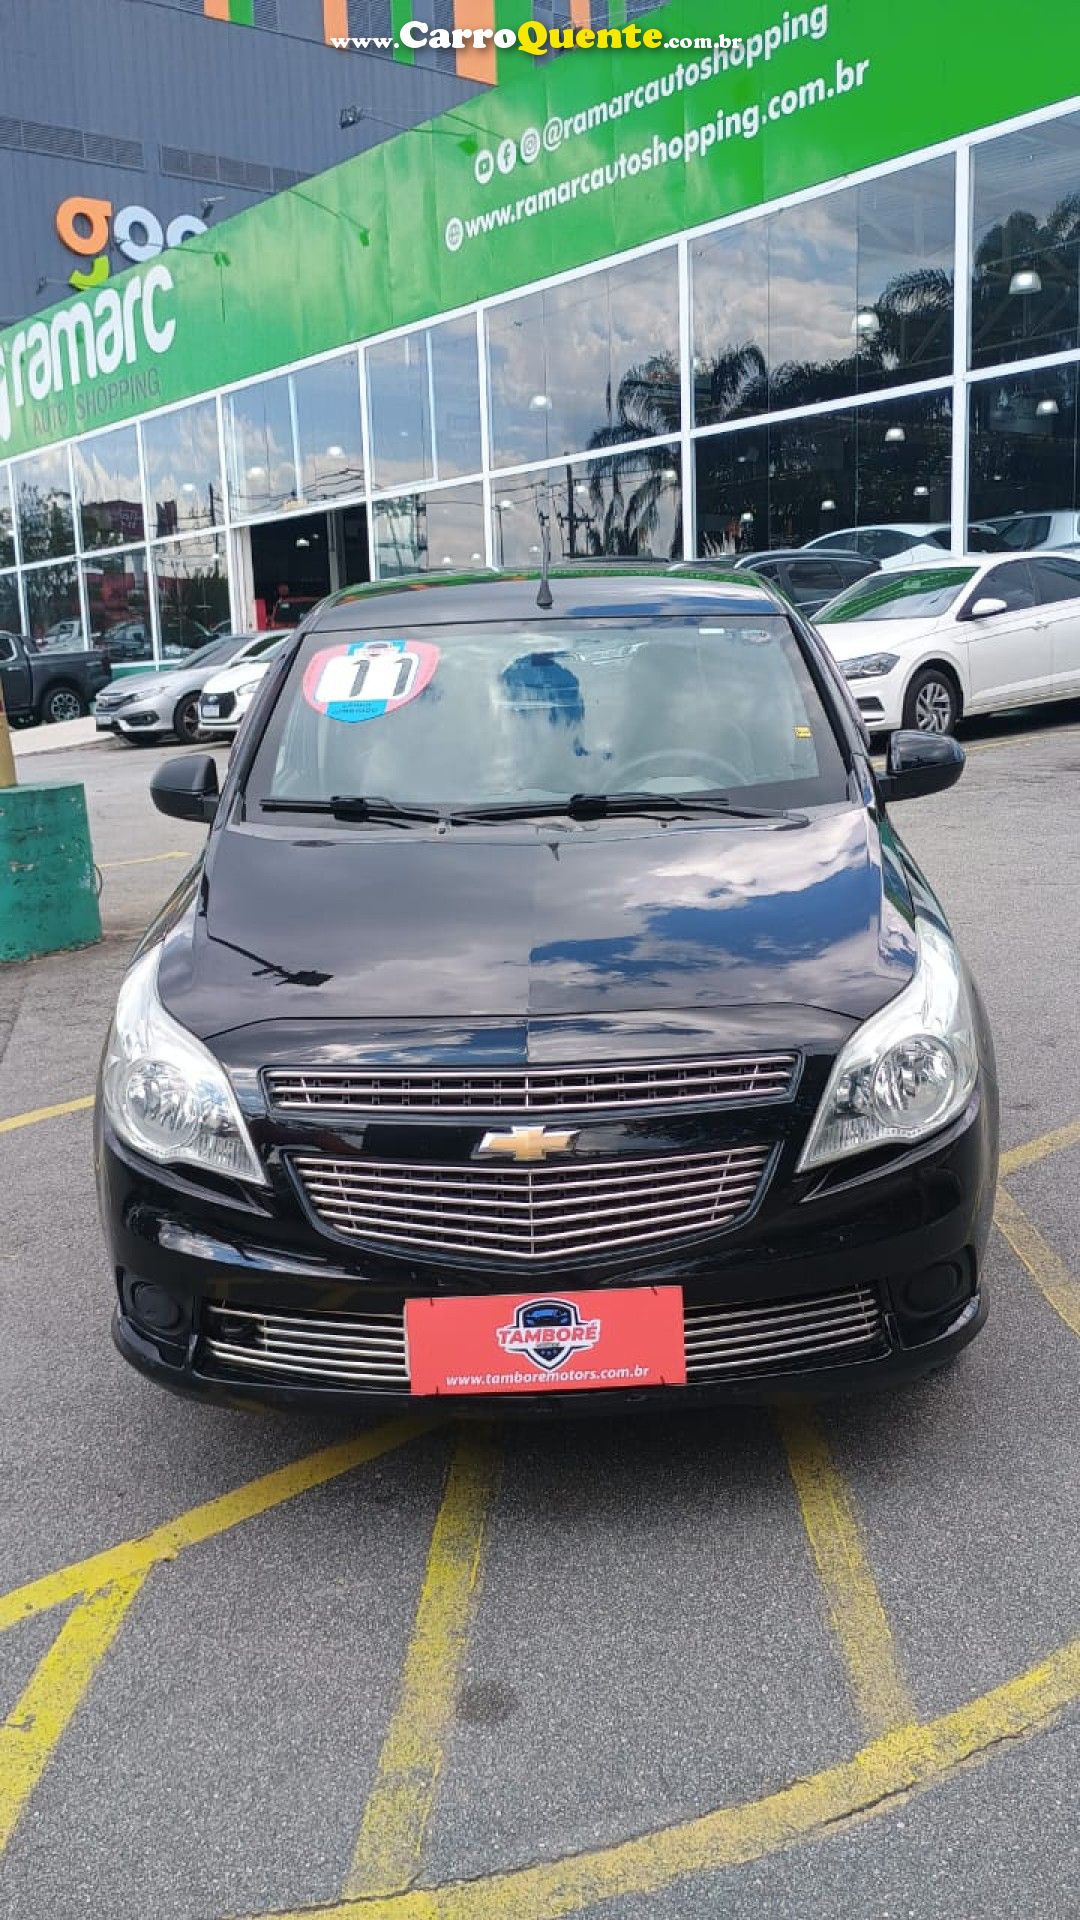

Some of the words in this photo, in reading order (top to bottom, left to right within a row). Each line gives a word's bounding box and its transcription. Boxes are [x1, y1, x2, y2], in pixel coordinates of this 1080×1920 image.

[543, 3, 829, 152] @ramarcautoshopping
[465, 57, 871, 238] www.ramarcautoshopping.com.br
[11, 265, 176, 408] ramarc
[33, 401, 68, 434] AUTO
[76, 367, 161, 421] SHOPPING
[349, 657, 413, 698] 11
[499, 1322, 598, 1345] TAMBORÉ
[446, 1364, 650, 1386] www.tamboremotors.com.br
